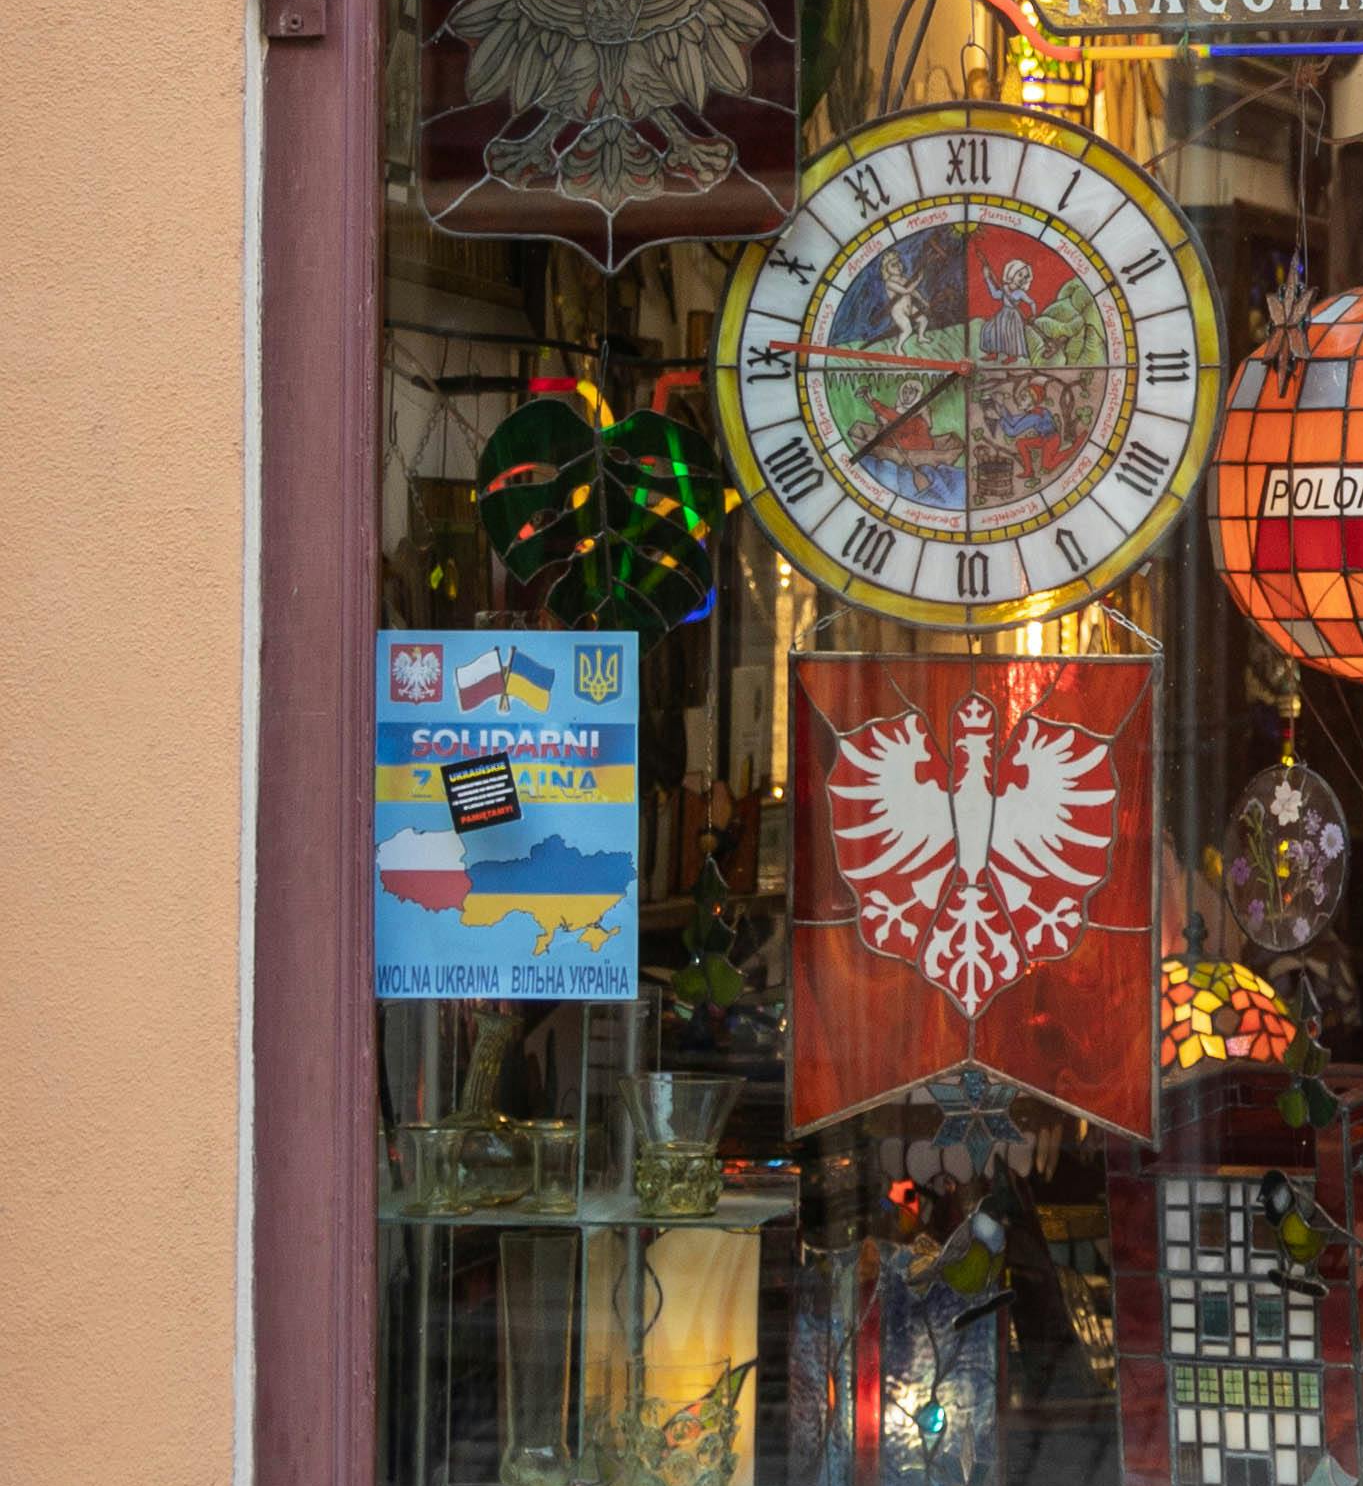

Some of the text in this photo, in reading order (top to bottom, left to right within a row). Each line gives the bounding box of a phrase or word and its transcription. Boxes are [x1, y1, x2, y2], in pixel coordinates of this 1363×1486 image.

[411, 728, 601, 758] SOLIDARNI
[376, 965, 500, 995] WOLNA UKRAINA
[511, 959, 630, 995] ВІЛЬНА УКРАЇНА
